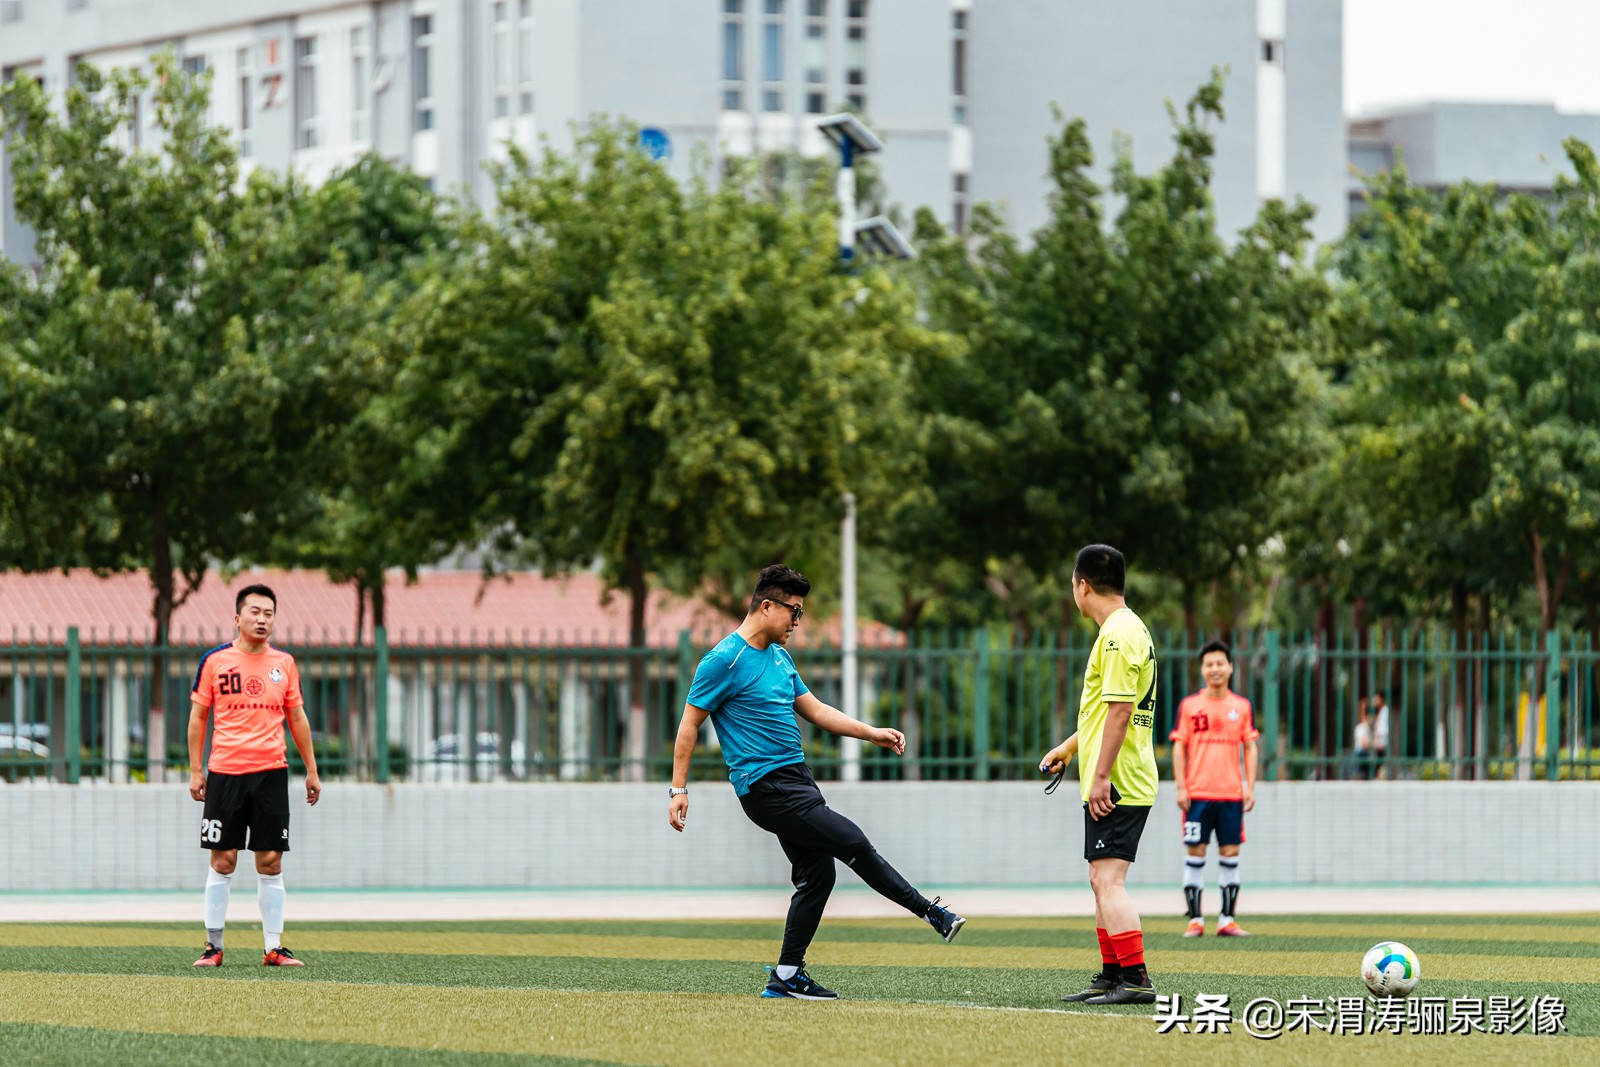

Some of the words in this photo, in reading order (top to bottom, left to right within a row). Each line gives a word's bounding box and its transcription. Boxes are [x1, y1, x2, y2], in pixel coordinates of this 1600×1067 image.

[218, 672, 242, 695] 20
[1191, 714, 1209, 733] 33
[202, 818, 222, 843] 26
[1184, 821, 1202, 842] 33
